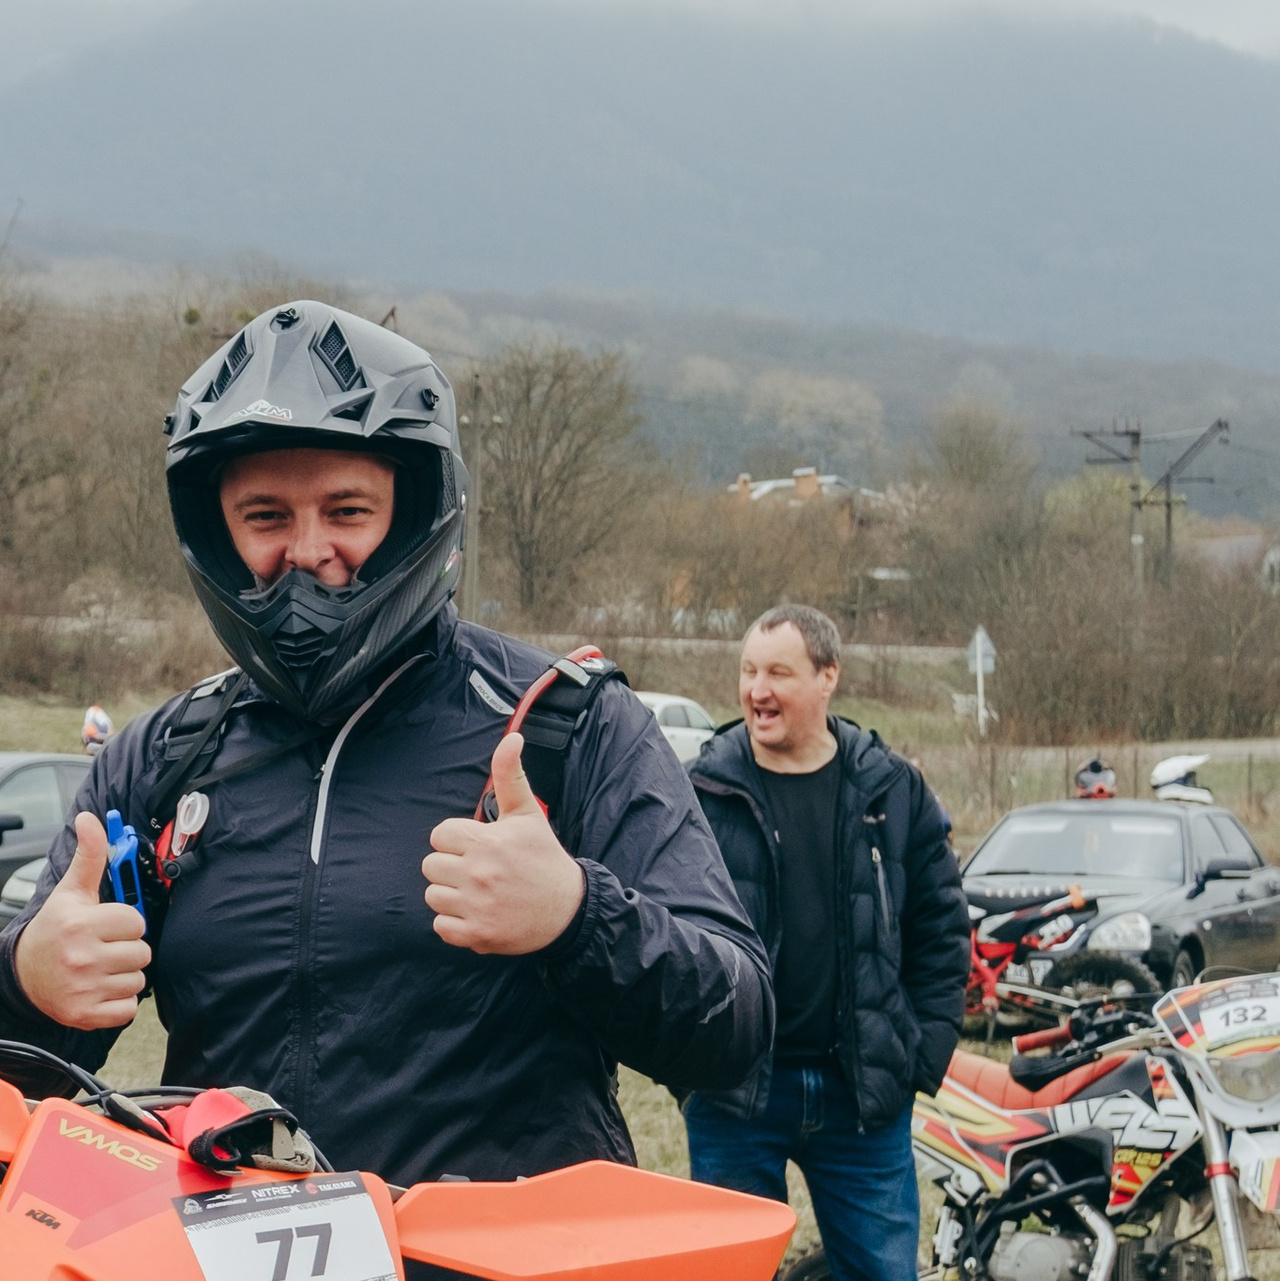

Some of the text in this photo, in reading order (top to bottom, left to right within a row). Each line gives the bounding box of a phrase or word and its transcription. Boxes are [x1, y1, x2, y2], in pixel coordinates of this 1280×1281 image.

[1220, 1006, 1267, 1027] 132
[59, 1117, 164, 1172] VAMOS
[251, 1184, 300, 1198] NITREX
[24, 1209, 61, 1230] KTM
[255, 1222, 332, 1281] 77
